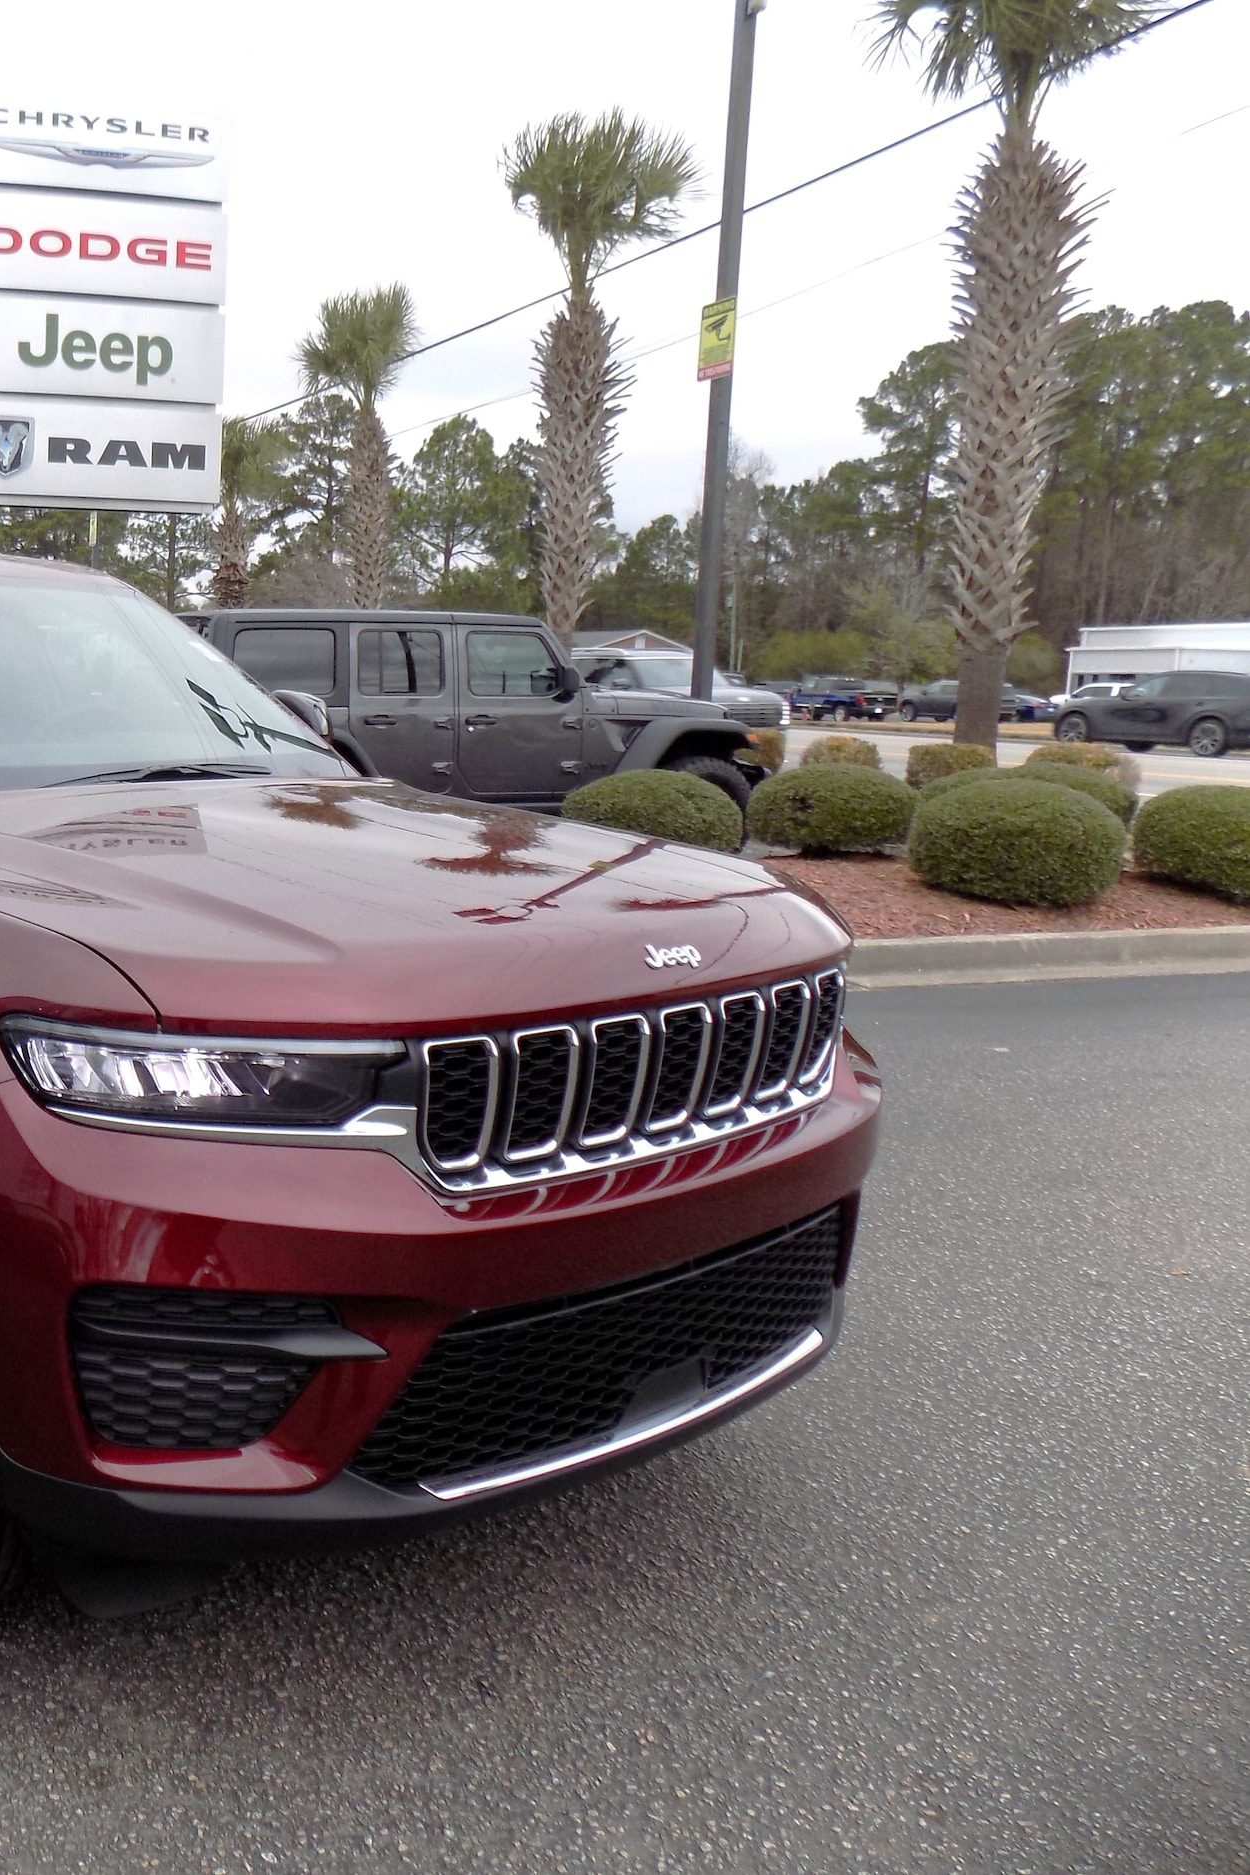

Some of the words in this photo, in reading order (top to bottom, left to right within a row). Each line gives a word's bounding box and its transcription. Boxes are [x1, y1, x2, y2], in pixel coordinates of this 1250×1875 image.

[17, 312, 173, 386] Jeep
[47, 436, 206, 471] RAM
[644, 944, 702, 970] Jeep
